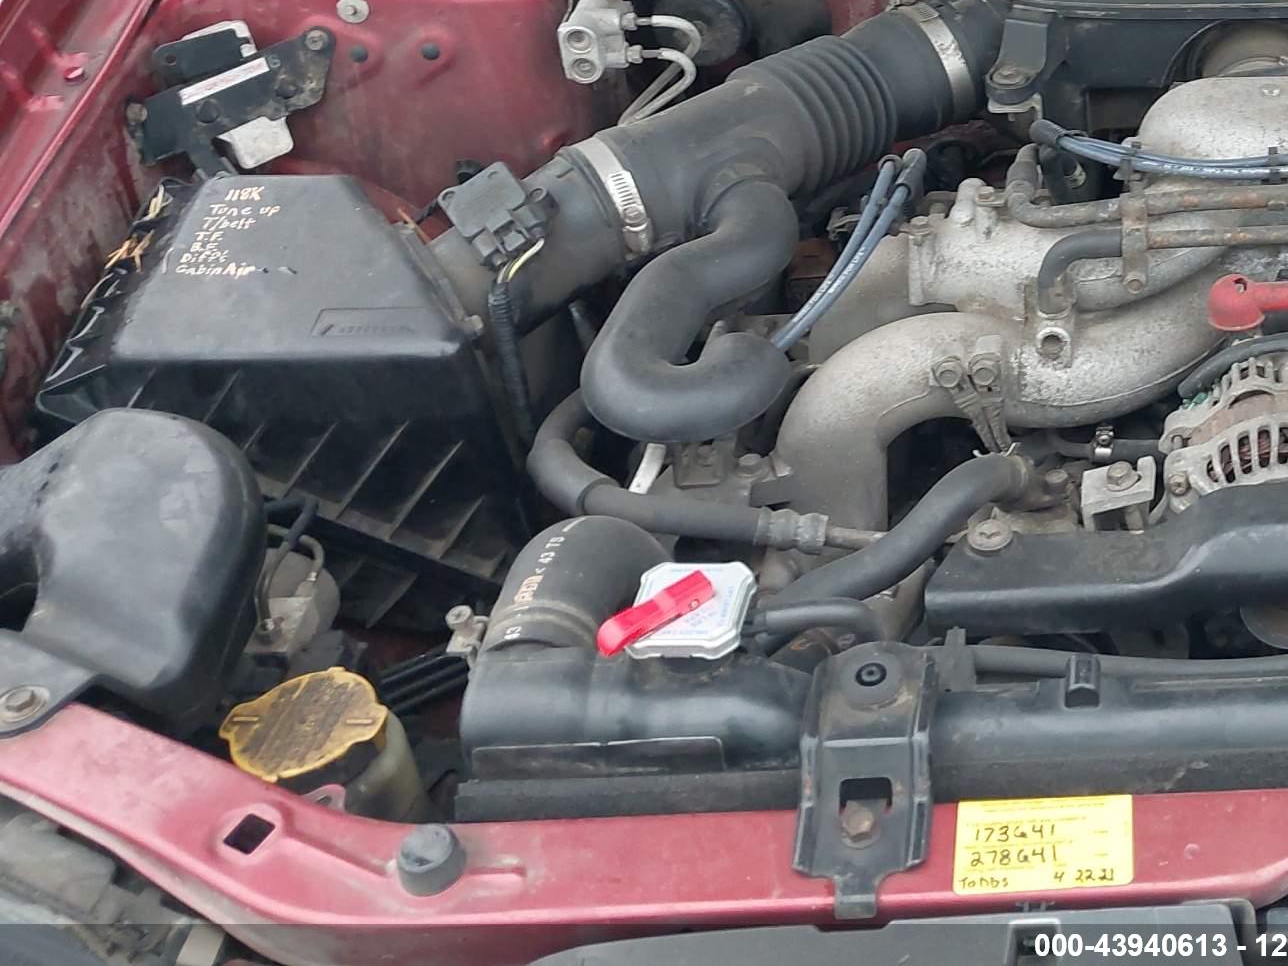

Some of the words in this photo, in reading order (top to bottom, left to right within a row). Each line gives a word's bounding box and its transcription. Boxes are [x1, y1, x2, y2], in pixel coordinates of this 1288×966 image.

[224, 186, 265, 202] 118K
[209, 203, 253, 216] Tune
[259, 205, 281, 217] up
[1053, 871, 1065, 883] 4
